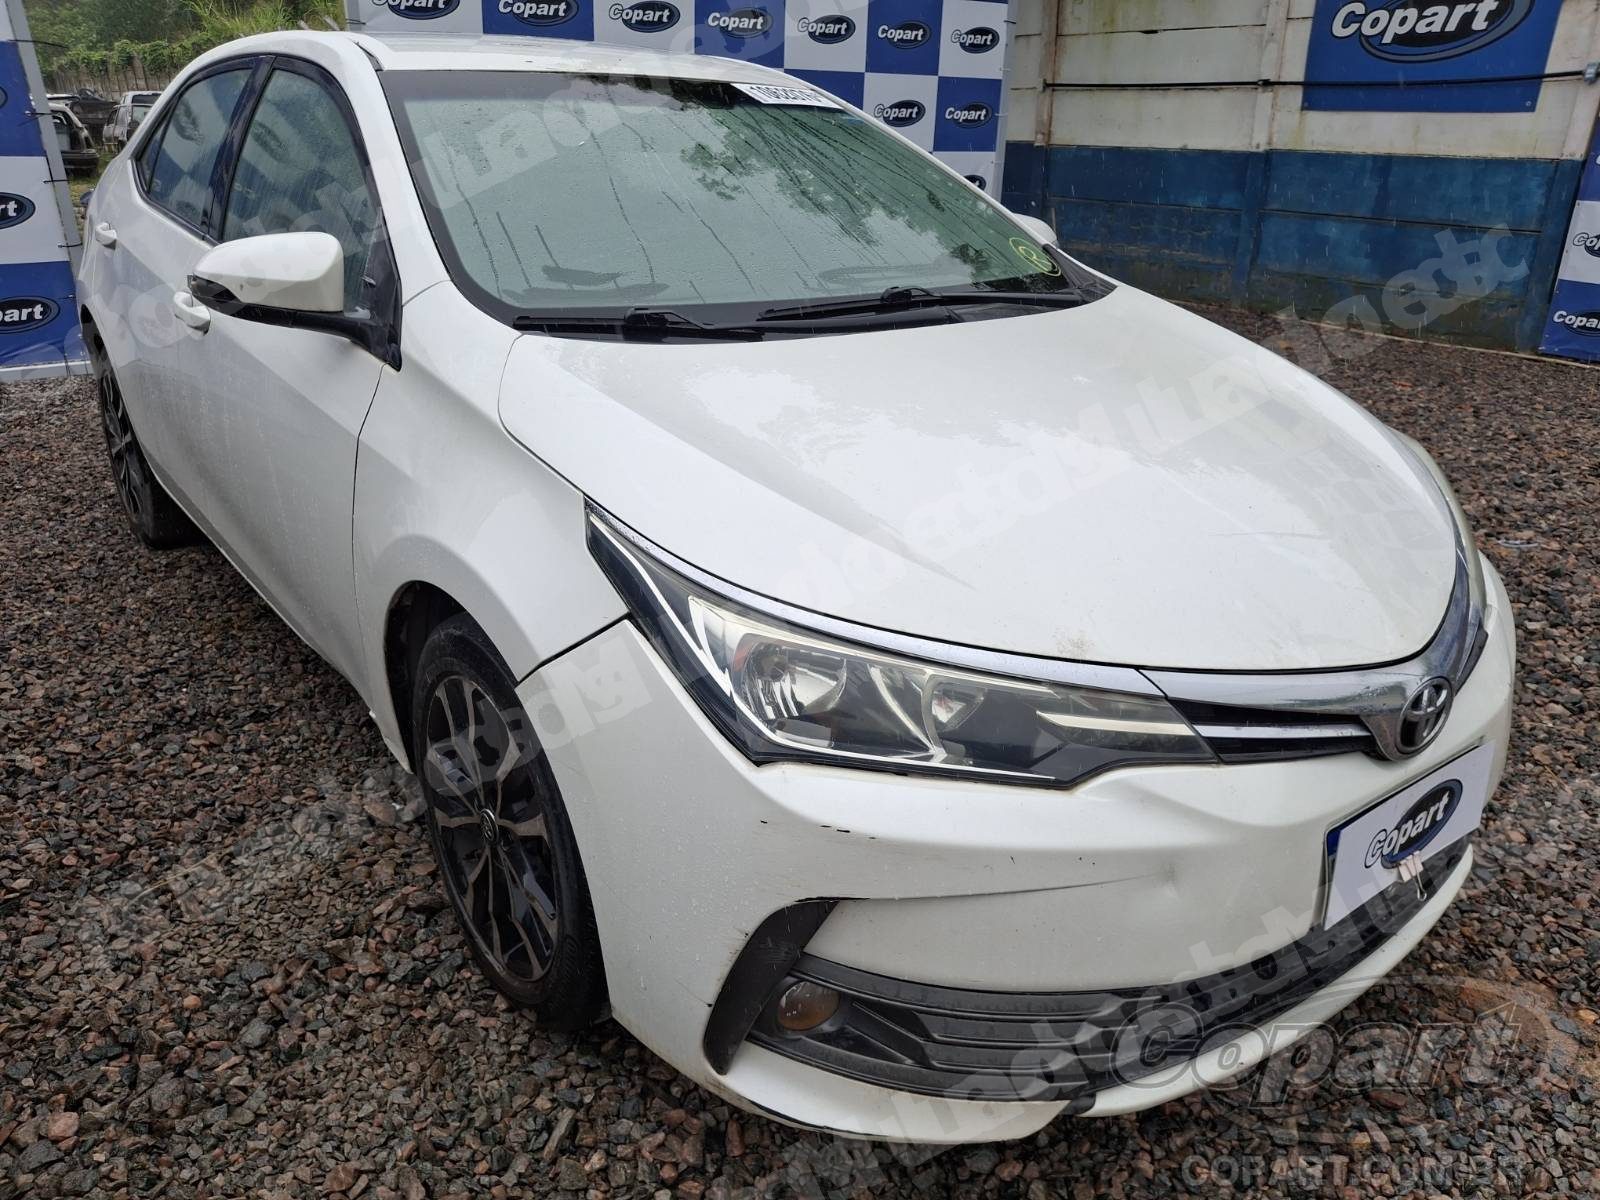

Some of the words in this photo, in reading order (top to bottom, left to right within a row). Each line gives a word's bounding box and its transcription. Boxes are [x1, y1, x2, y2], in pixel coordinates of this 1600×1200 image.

[498, 0, 567, 18] Copart
[609, 4, 671, 23] Copart
[707, 12, 764, 30] Copart
[798, 17, 848, 36] Copart
[1332, 0, 1499, 44] Copart
[878, 25, 924, 41] Copart
[951, 30, 993, 46] Copart
[874, 104, 919, 120] Copart
[945, 107, 987, 122] Copart
[1364, 790, 1451, 869] Copart
